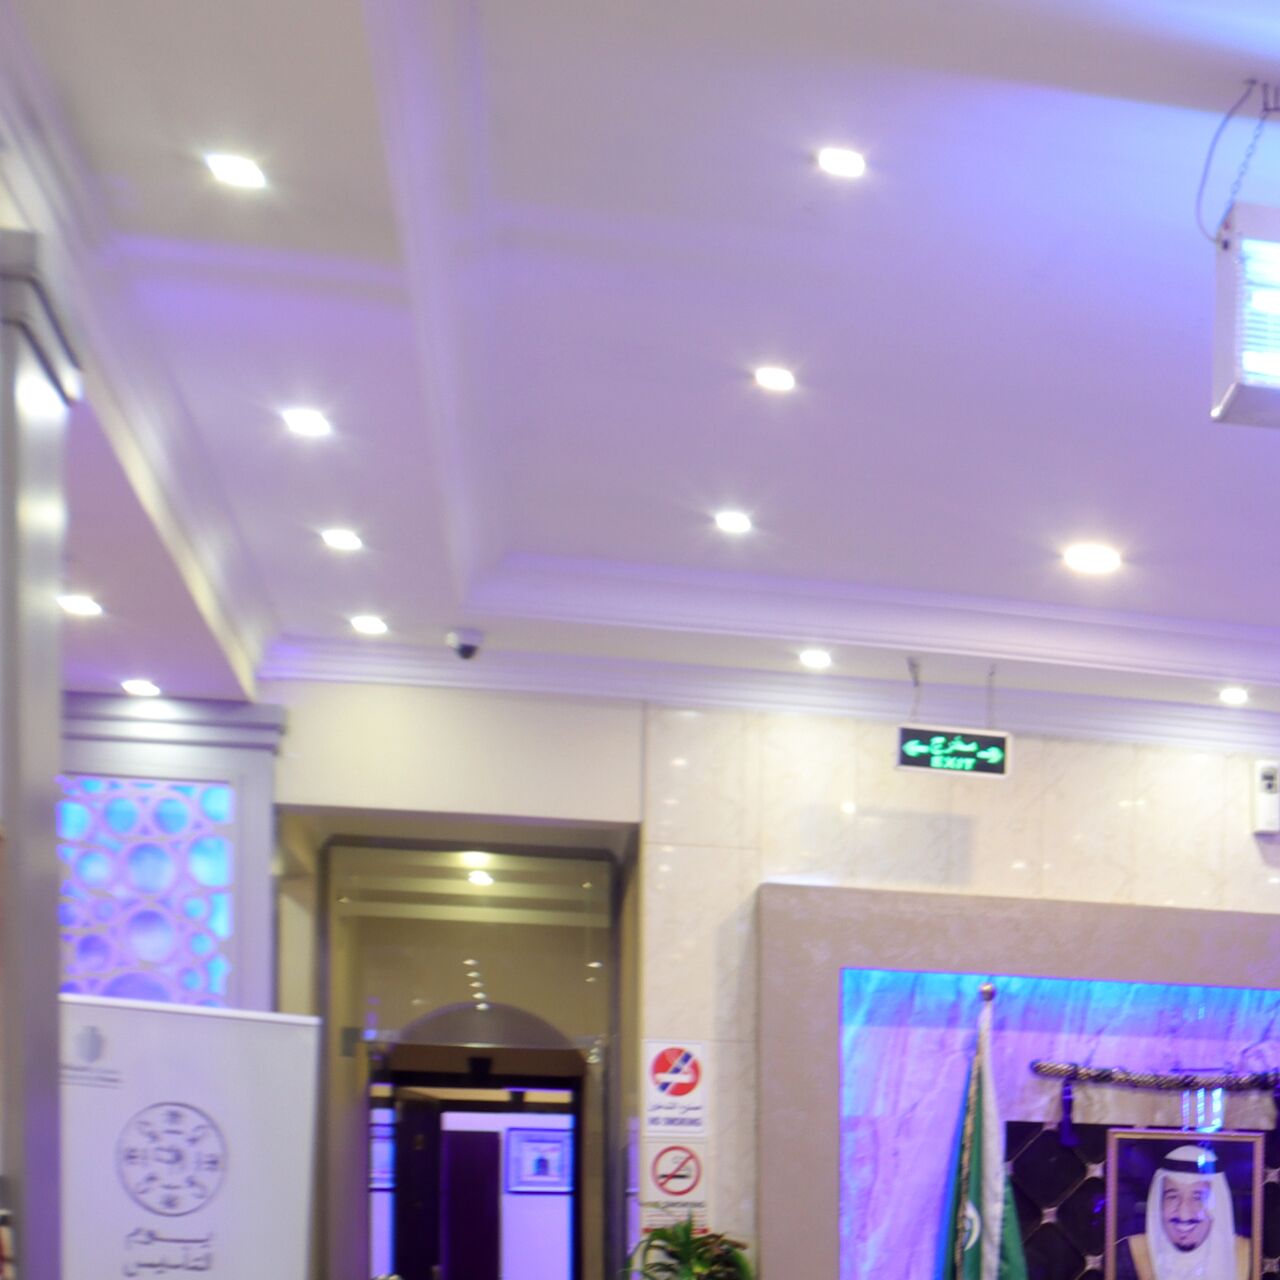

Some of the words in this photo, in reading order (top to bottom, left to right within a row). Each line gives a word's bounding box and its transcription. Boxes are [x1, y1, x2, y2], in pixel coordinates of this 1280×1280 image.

[930, 735, 978, 755] مخرج
[931, 755, 976, 771] EXIT
[663, 1117, 702, 1127] SMOKING
